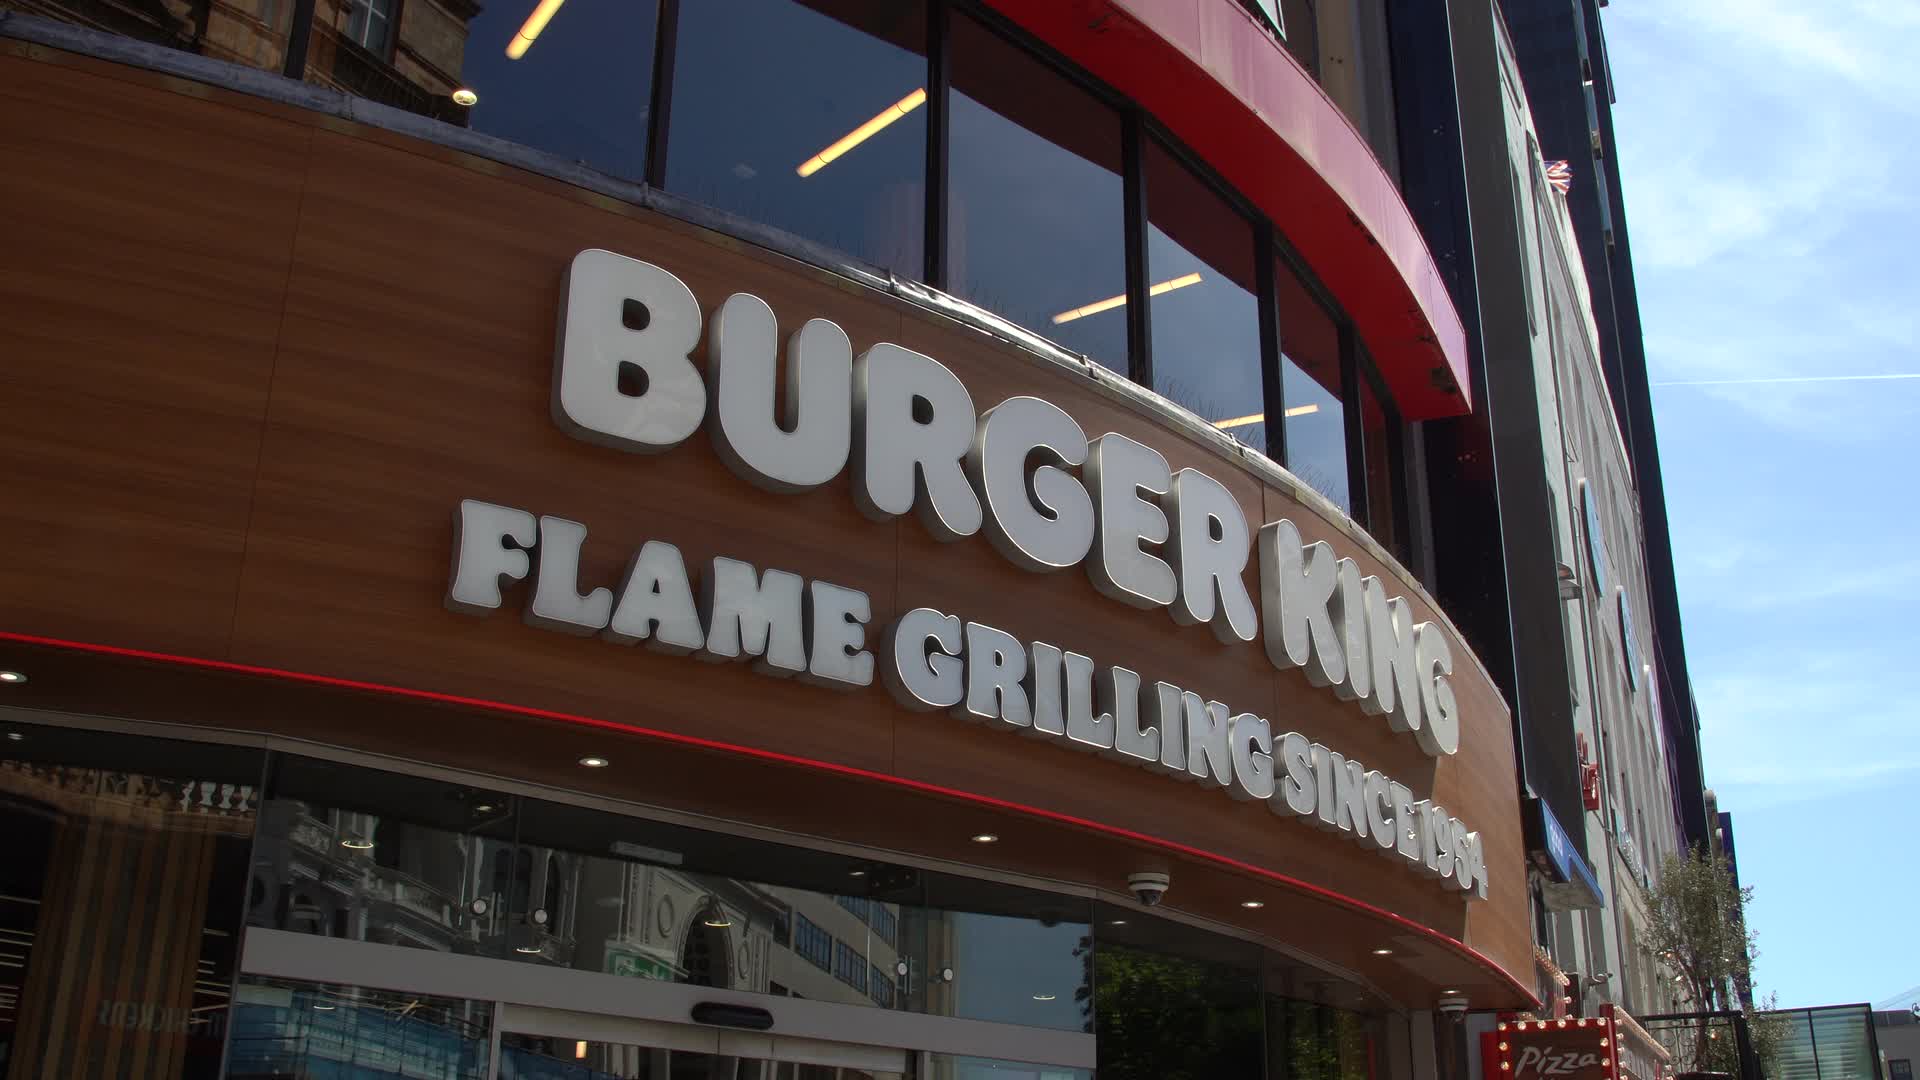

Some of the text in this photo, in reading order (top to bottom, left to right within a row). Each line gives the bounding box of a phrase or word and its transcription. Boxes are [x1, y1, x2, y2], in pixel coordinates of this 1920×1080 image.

[447, 499, 1489, 901] FLAME GRILLING SINCE 1954
[552, 248, 1459, 756] BURGER KING
[1515, 1046, 1600, 1078] Pizza
